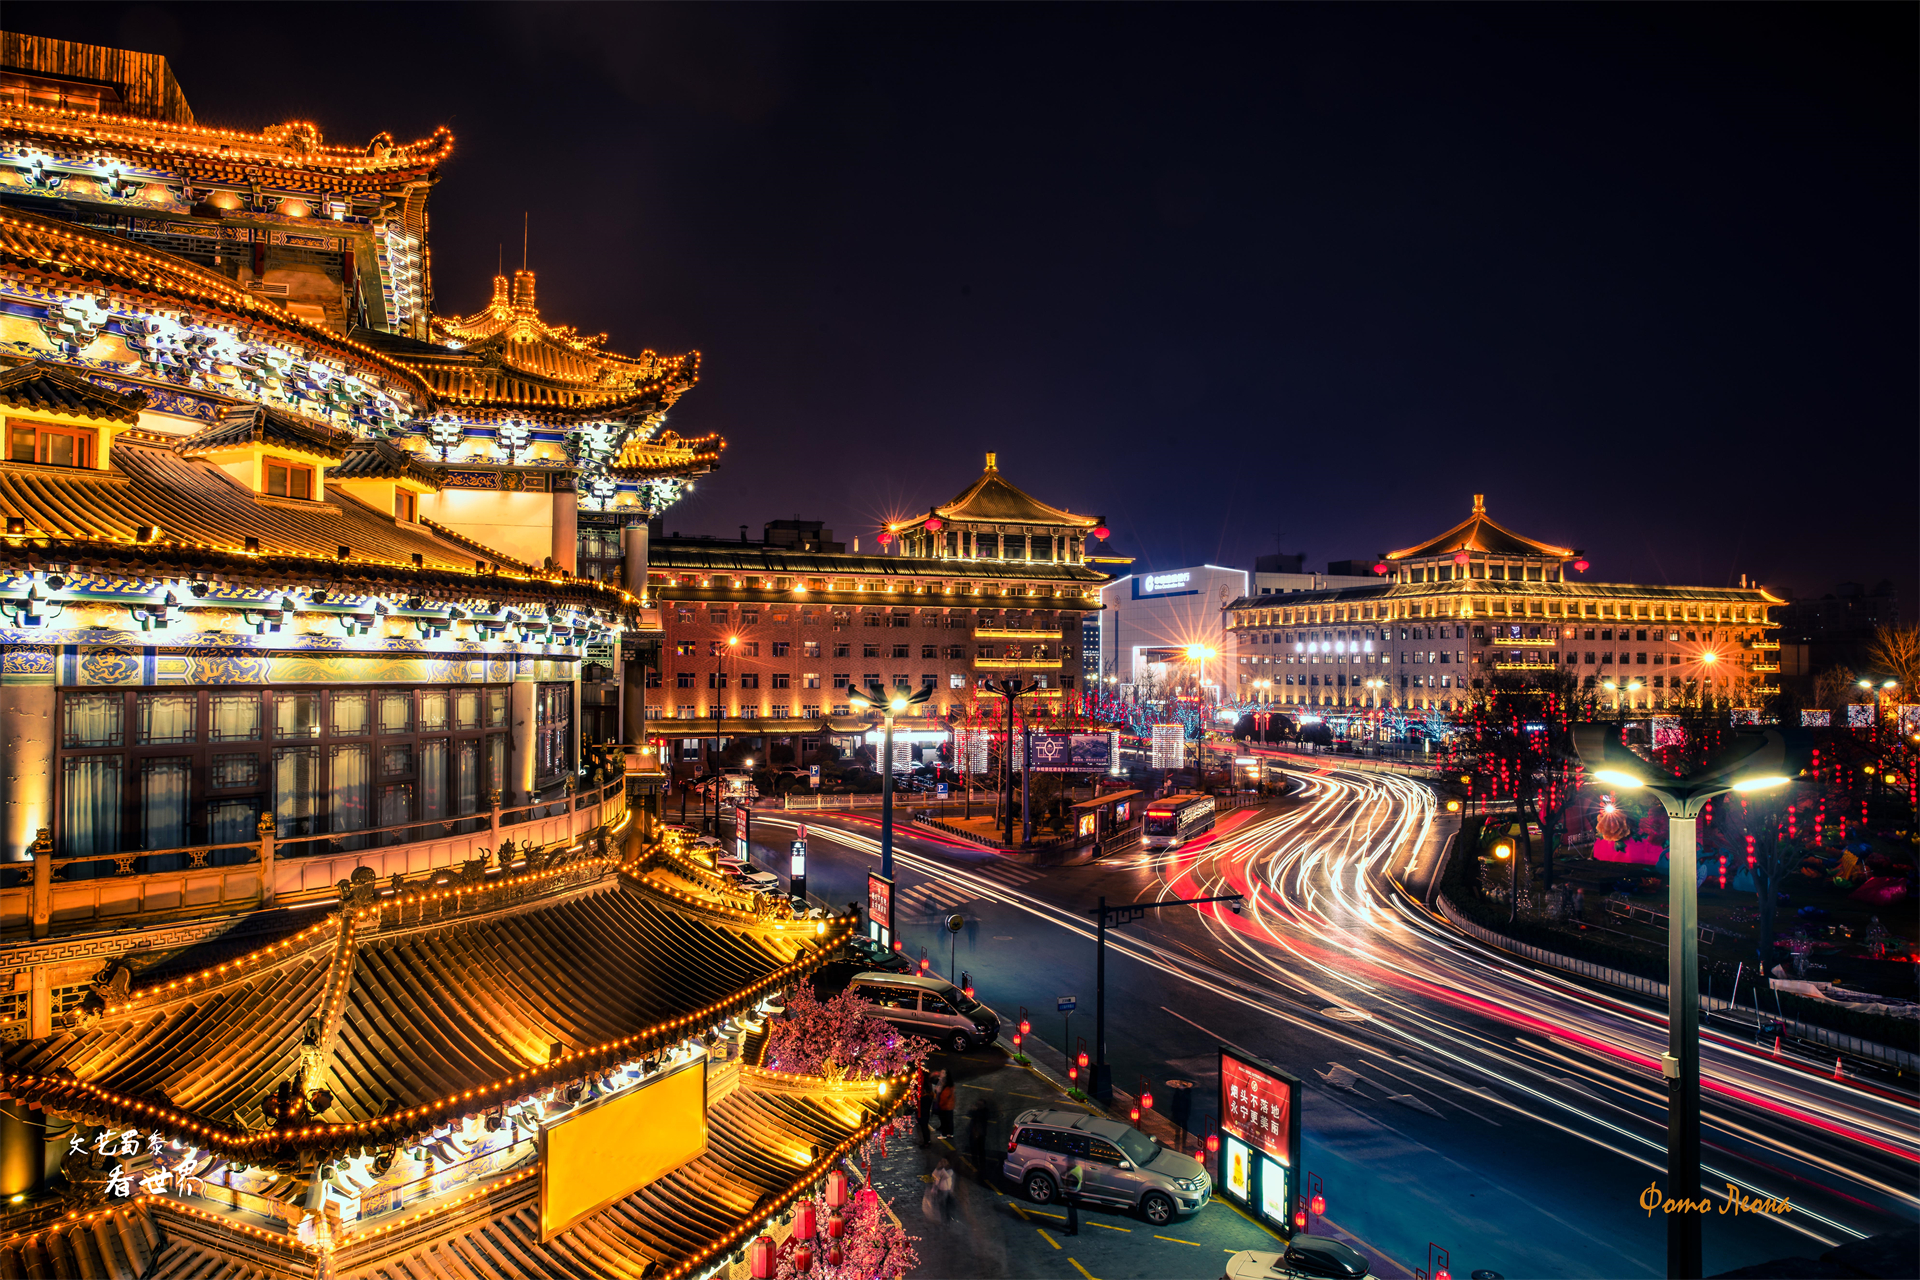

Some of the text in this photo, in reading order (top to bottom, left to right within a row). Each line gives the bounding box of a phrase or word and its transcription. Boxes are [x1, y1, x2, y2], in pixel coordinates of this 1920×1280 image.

[812, 766, 818, 775] P
[938, 784, 944, 793] P
[1230, 1083, 1280, 1120] 烟头不落地
[1230, 1101, 1280, 1136] 永宁更美丽
